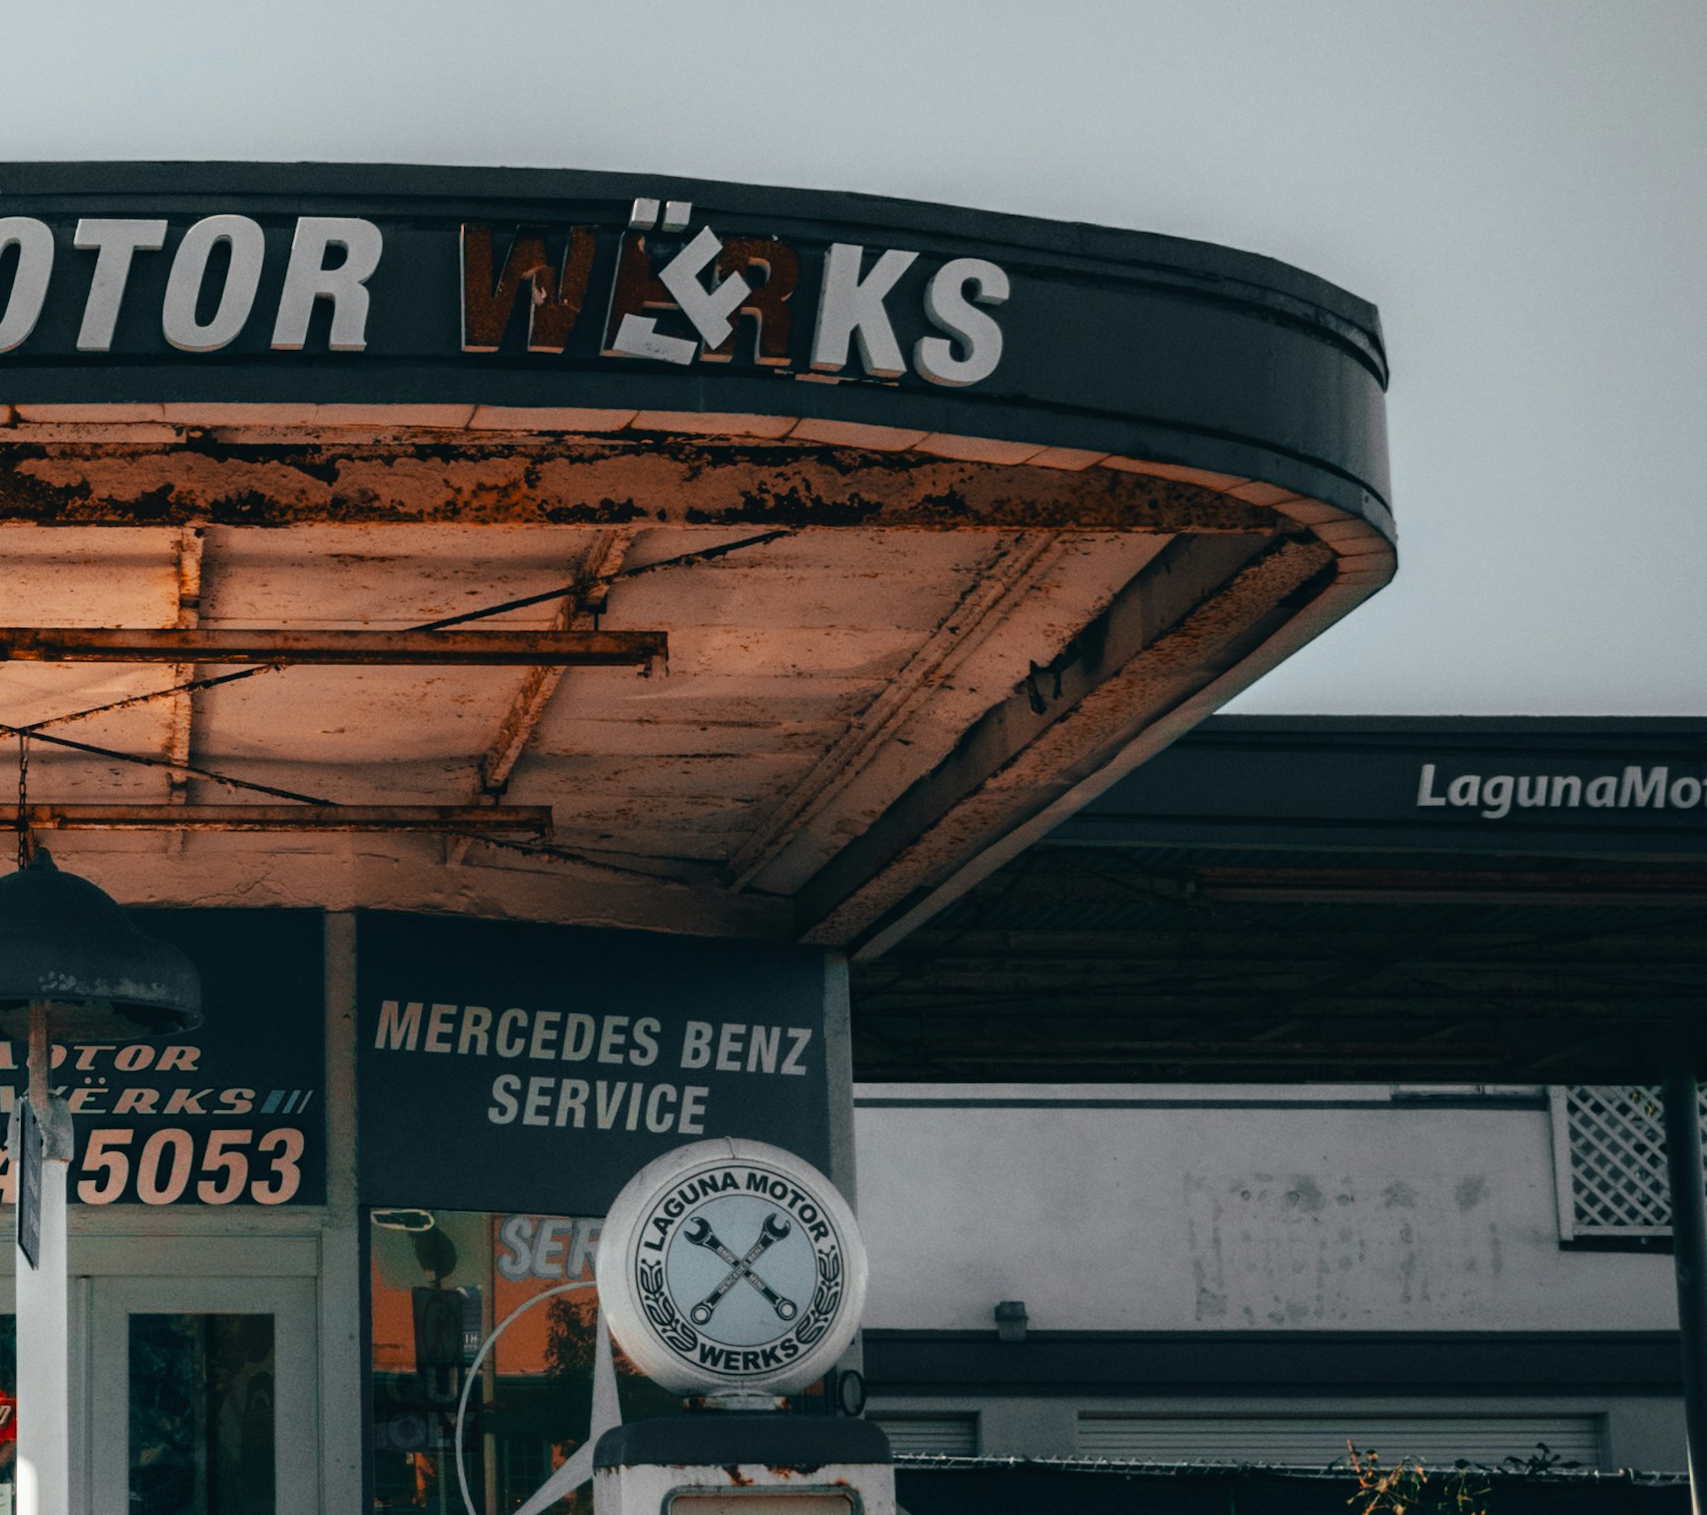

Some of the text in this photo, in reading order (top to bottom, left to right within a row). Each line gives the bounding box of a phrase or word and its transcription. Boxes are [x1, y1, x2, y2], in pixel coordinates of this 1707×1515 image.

[1416, 763, 1707, 819] LagunaMo
[374, 1000, 813, 1076] MERCEDES BENZ
[487, 1074, 710, 1135] SERVICE
[644, 1171, 830, 1252] LAGUNA MOTOR
[698, 1337, 799, 1371] WERKS
